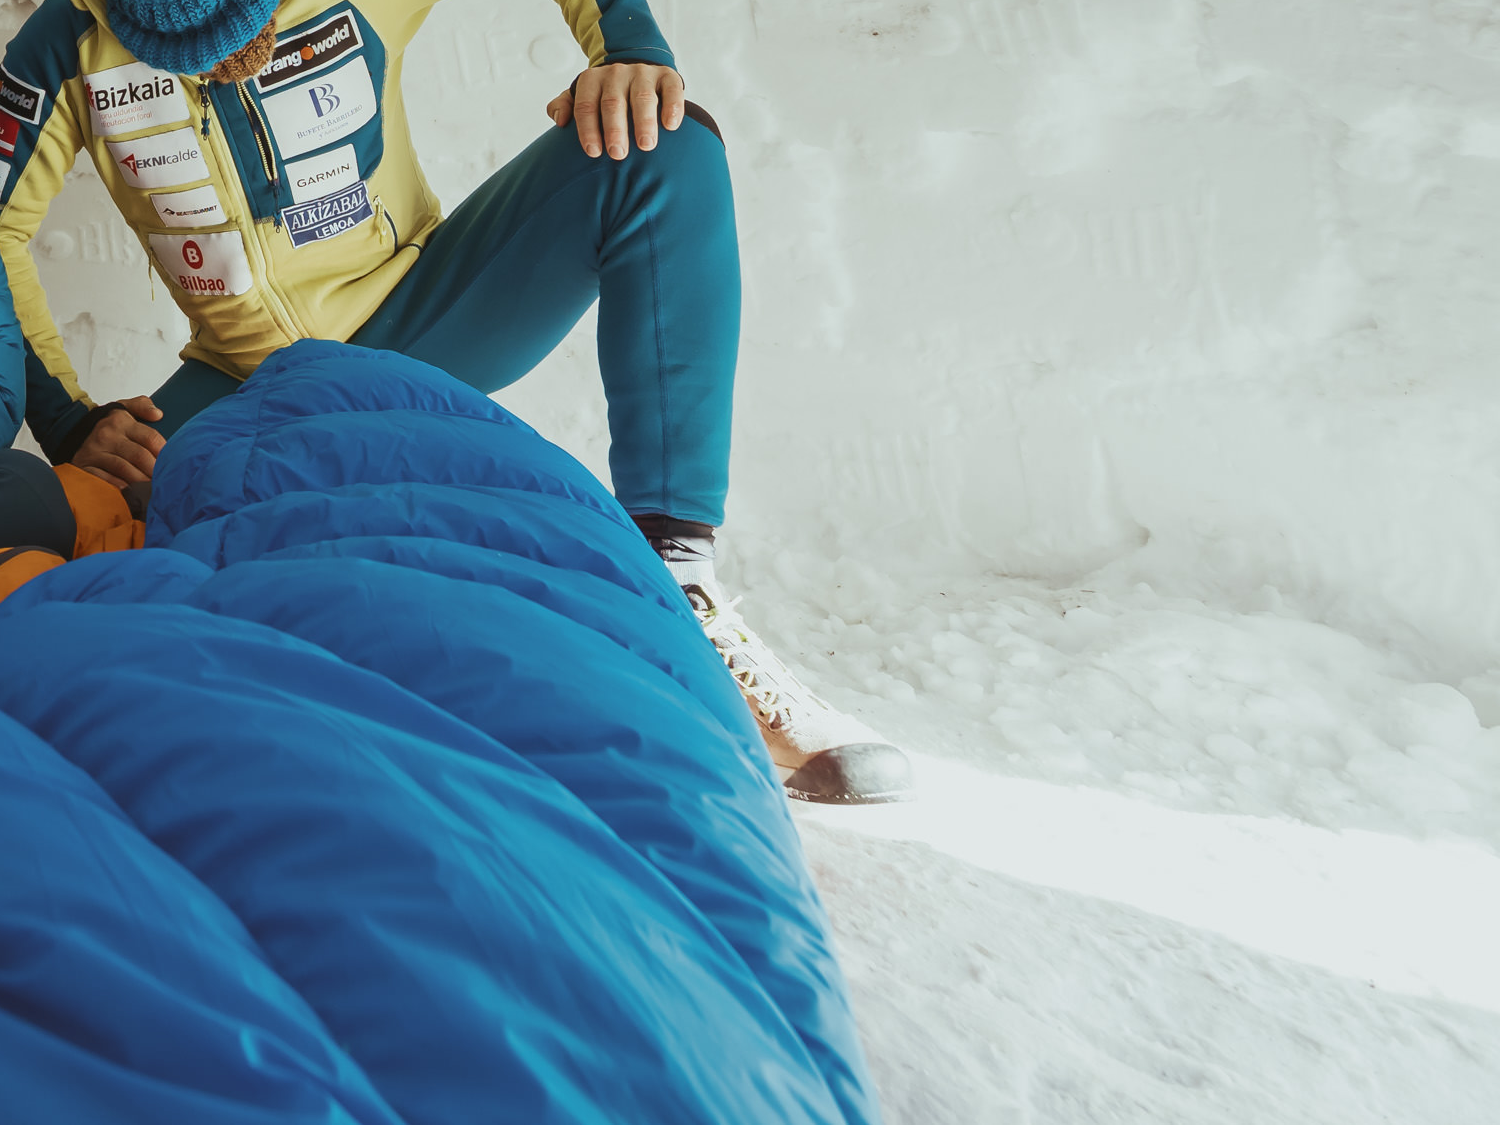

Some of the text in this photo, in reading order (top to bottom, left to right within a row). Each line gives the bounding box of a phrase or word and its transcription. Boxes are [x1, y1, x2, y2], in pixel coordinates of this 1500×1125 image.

[95, 76, 174, 111] Bizkaia
[297, 163, 350, 188] GARMIN
[315, 216, 356, 239] LEMOA
[186, 247, 200, 263] B
[178, 275, 226, 292] Bilbao
